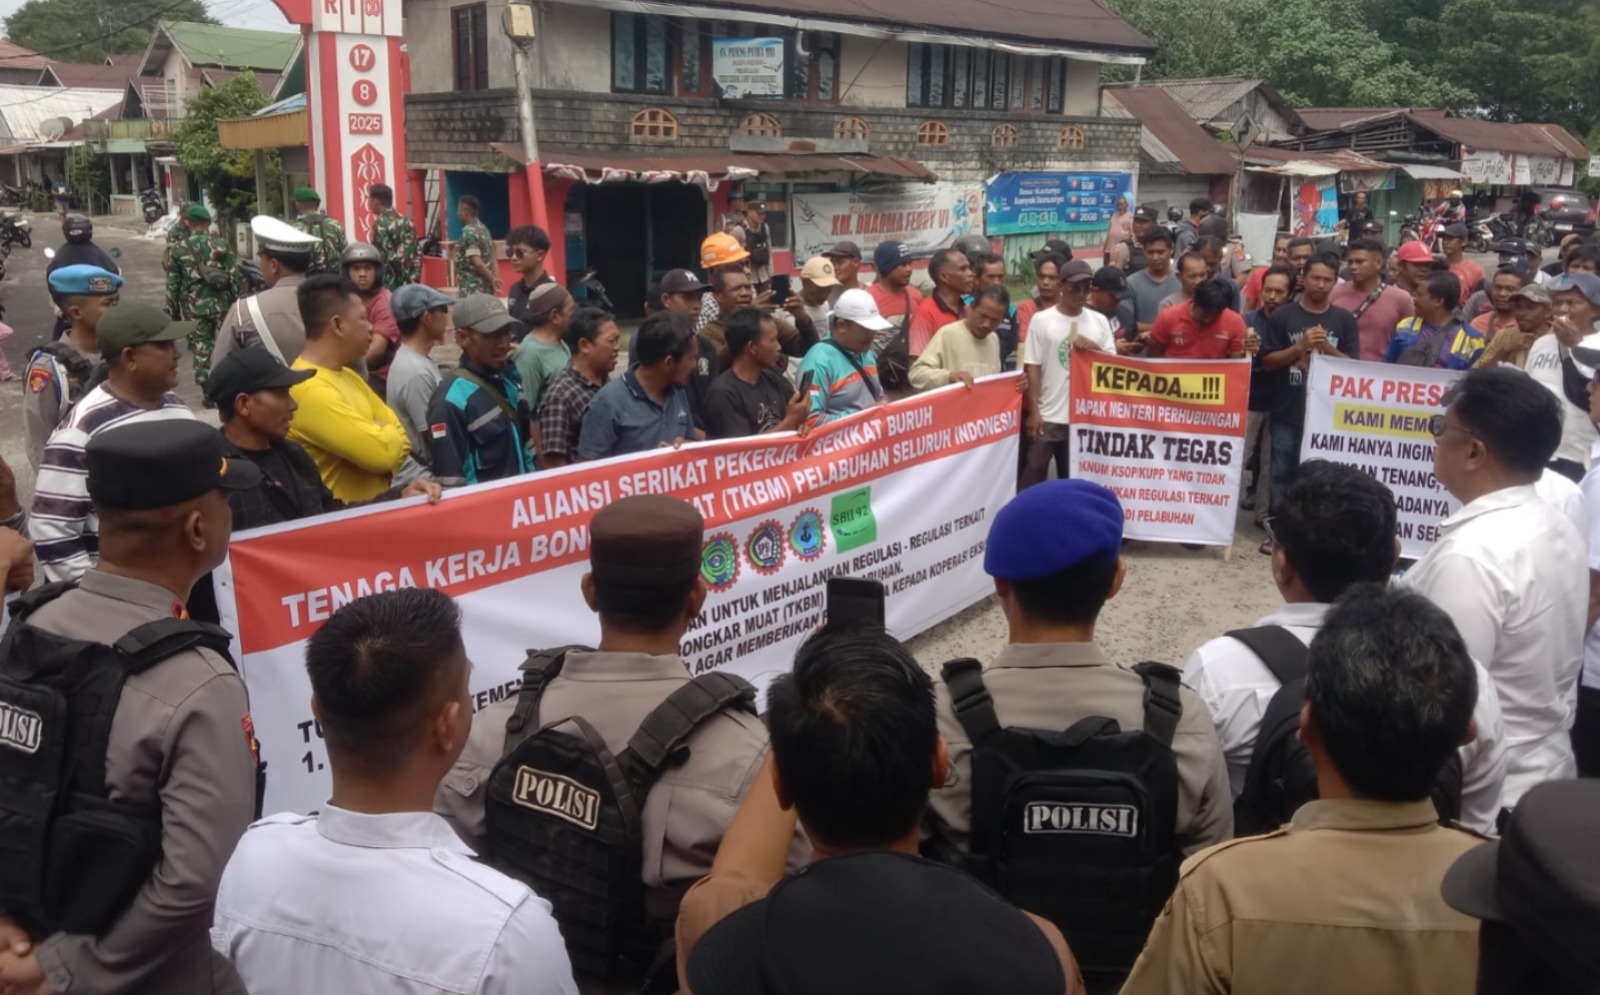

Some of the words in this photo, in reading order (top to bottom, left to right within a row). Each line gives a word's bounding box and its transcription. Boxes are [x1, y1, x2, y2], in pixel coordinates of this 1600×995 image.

[353, 48, 371, 66] 17
[359, 83, 370, 100] 8
[350, 115, 380, 131] 2025
[831, 213, 853, 236] KM.
[855, 211, 904, 235] DHARMA
[938, 208, 949, 229] VI
[1330, 374, 1374, 400] PAK
[1110, 401, 1155, 422] MENTERI
[1158, 405, 1241, 429] PERHUBUNGAN
[1344, 409, 1385, 428] KAMI
[1077, 428, 1156, 459] TINDAK
[1163, 436, 1233, 466] TEGAS
[1310, 433, 1344, 452] KAMI
[1349, 437, 1393, 458] HANYA
[1397, 441, 1436, 462] INGIN
[512, 480, 611, 528] ALIANSI
[618, 459, 708, 500] SERIKAT
[715, 443, 798, 480] PEKERJA
[812, 418, 882, 457] SERIKAT
[886, 405, 933, 437] BURUH
[1168, 469, 1193, 482] YANG
[1196, 471, 1226, 485] TIDAK
[1382, 467, 1440, 493] TENANG,
[1139, 488, 1185, 503] REGULASI
[1188, 491, 1230, 507] TERKAIT
[1396, 495, 1449, 518] ADANYA
[281, 566, 418, 627] TENAGA
[425, 544, 521, 590] KERJA
[722, 475, 793, 519] (TKBM)
[792, 447, 889, 493] PELABUHAN
[893, 426, 951, 464] SELURUH
[955, 410, 1017, 446] INDONESIA
[1137, 509, 1194, 525] PELABUHAN
[711, 591, 759, 623] UNTUK
[763, 560, 850, 604] MENJALANKAN
[853, 541, 902, 572] REGULASI
[909, 521, 951, 550] REGULASI
[954, 507, 985, 532] TERKAIT
[679, 622, 741, 657] ONGKAR
[745, 608, 780, 634] MUAT
[783, 591, 824, 622] (TKBM)
[695, 647, 733, 675] AGAR
[736, 613, 819, 658] MEMBERIKAN
[892, 570, 928, 597] KEPADA
[930, 550, 967, 578] KOPERASI
[519, 772, 596, 823] POLISI
[1031, 805, 1131, 832] POLISI
